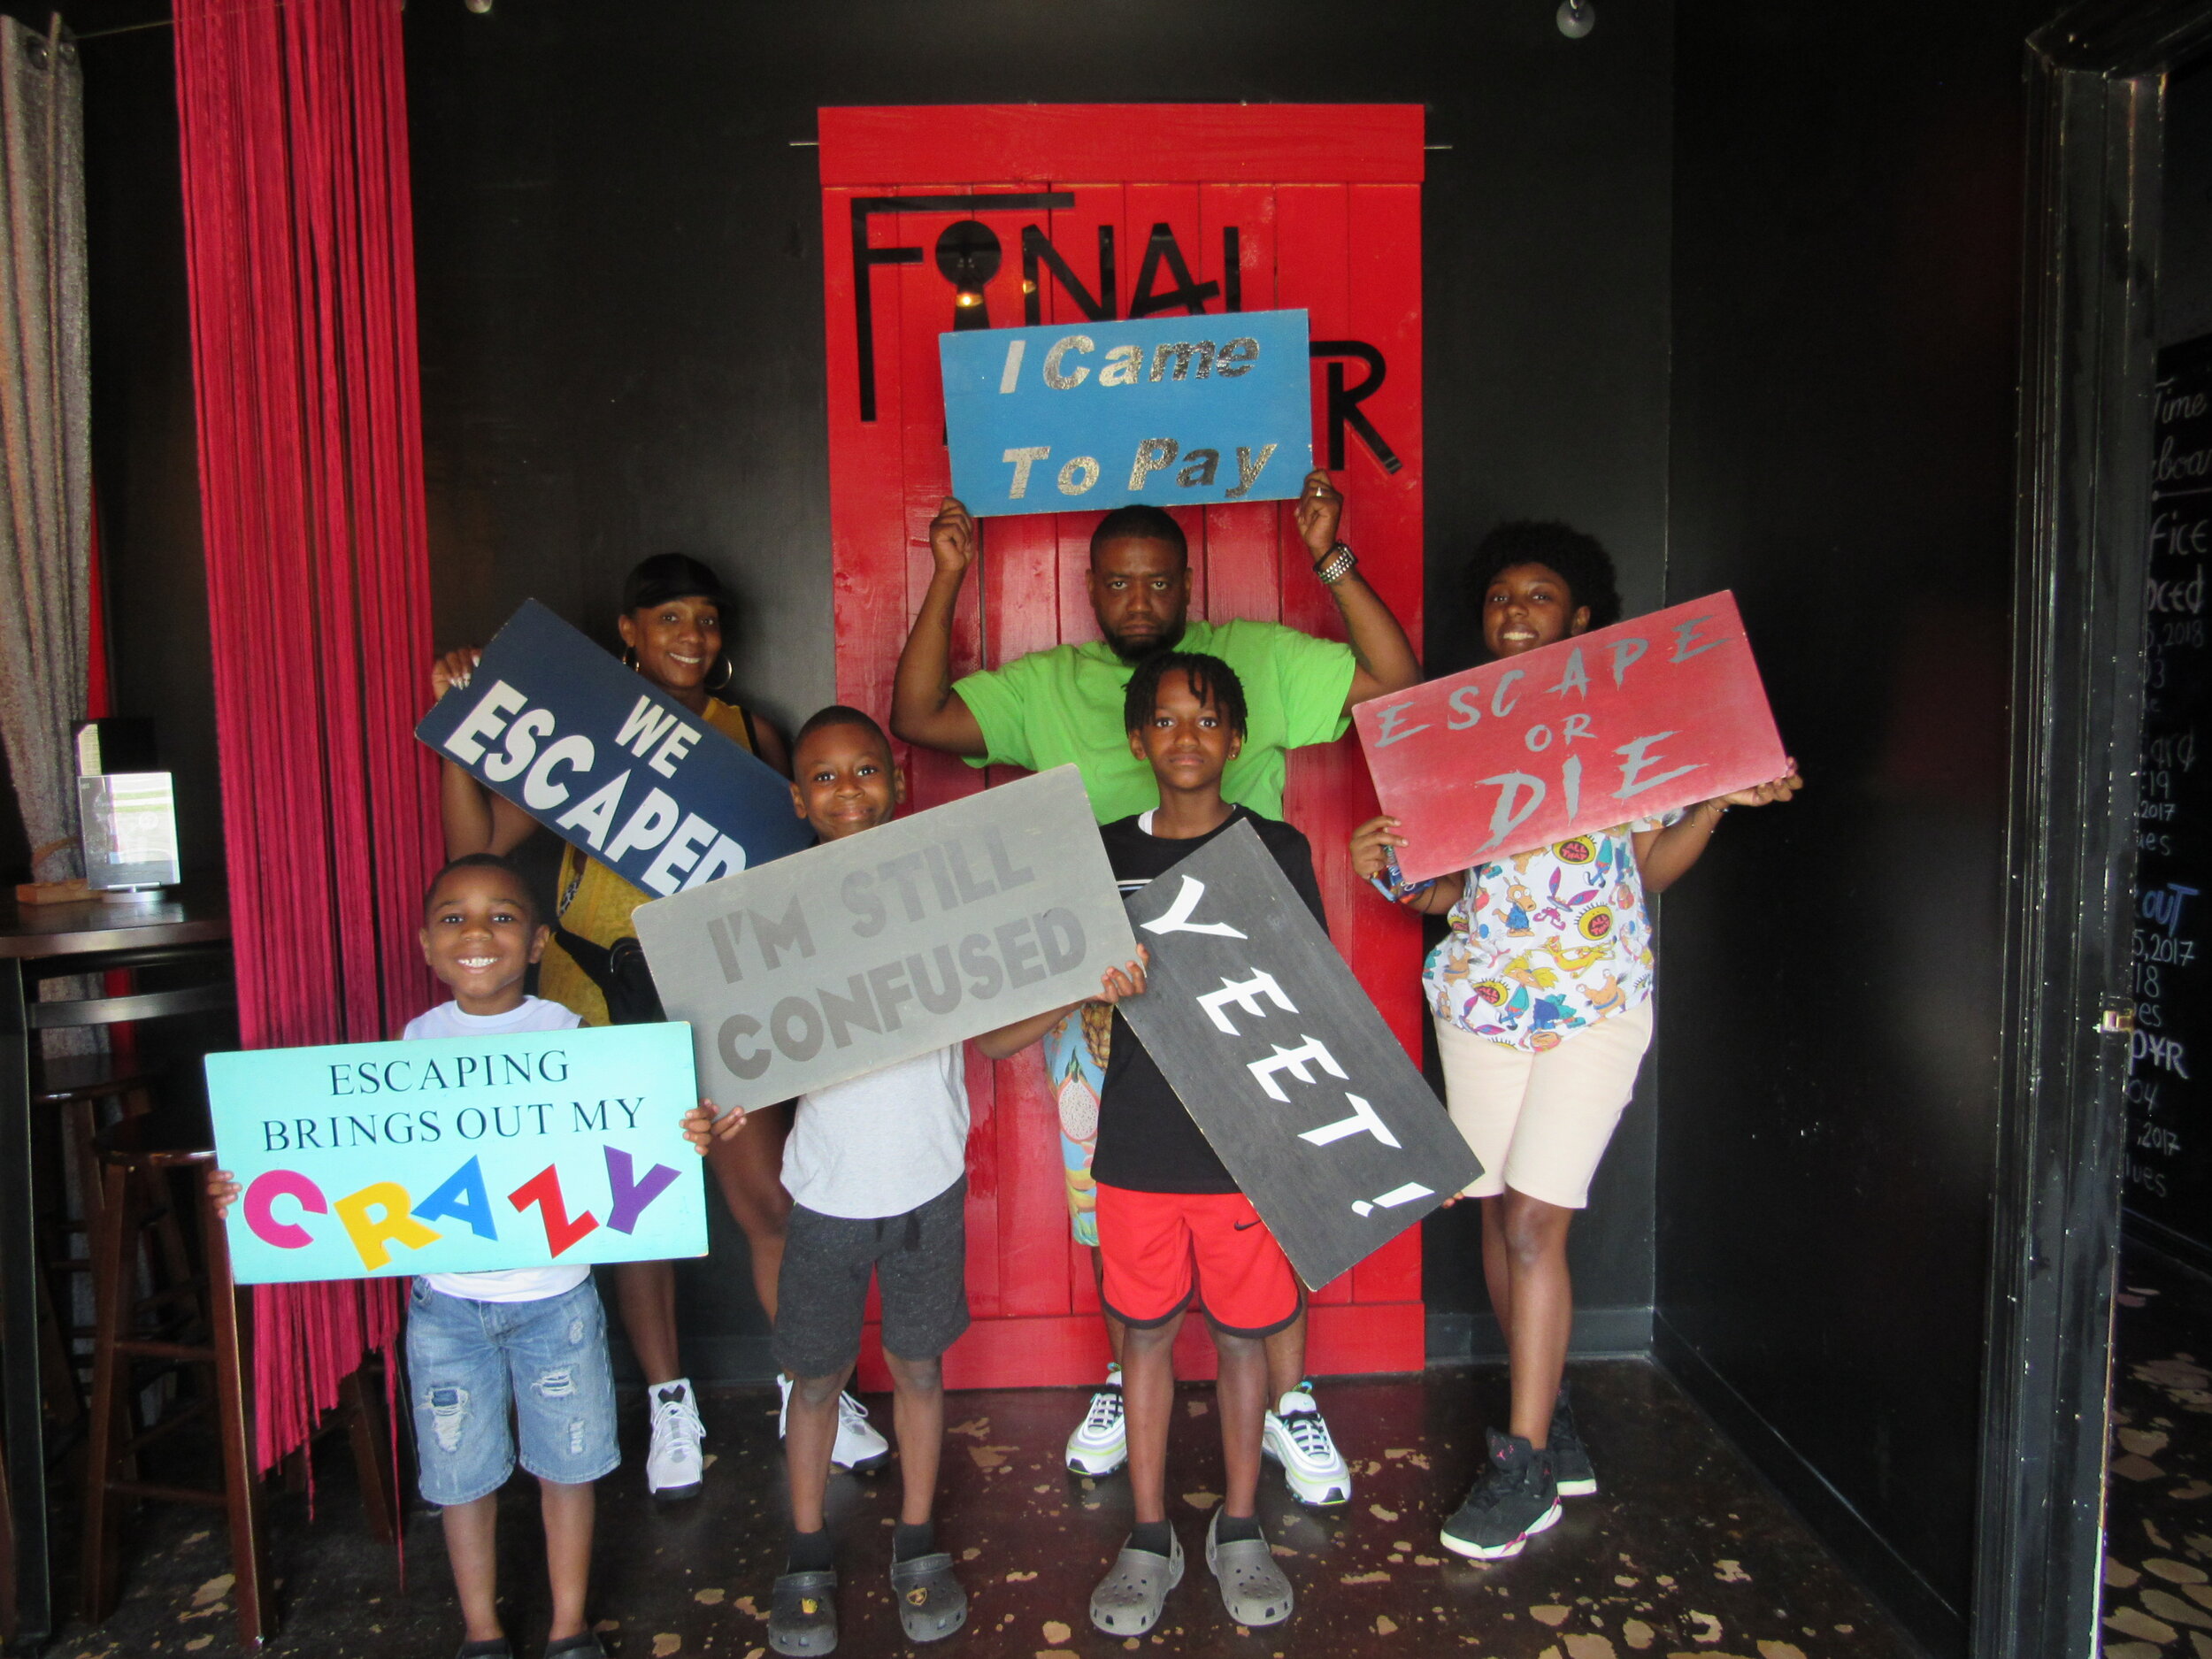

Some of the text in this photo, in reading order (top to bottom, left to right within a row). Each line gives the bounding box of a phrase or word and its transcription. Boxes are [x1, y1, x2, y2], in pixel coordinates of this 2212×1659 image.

[999, 334, 1260, 395] I Came
[1001, 437, 1279, 500] To Pay
[1373, 614, 1734, 749] ESCAPE
[1525, 713, 1597, 753] OR
[615, 695, 703, 779] WE
[1469, 731, 1709, 858] DIE
[707, 824, 1036, 985] I'M STILL
[717, 906, 1087, 1080] CONFUSED
[1140, 874, 1435, 1217] YEET!
[261, 1096, 646, 1152] BRINGS OUT MY
[327, 1049, 570, 1096] ESCAPING
[242, 1144, 683, 1272] CRAZY
